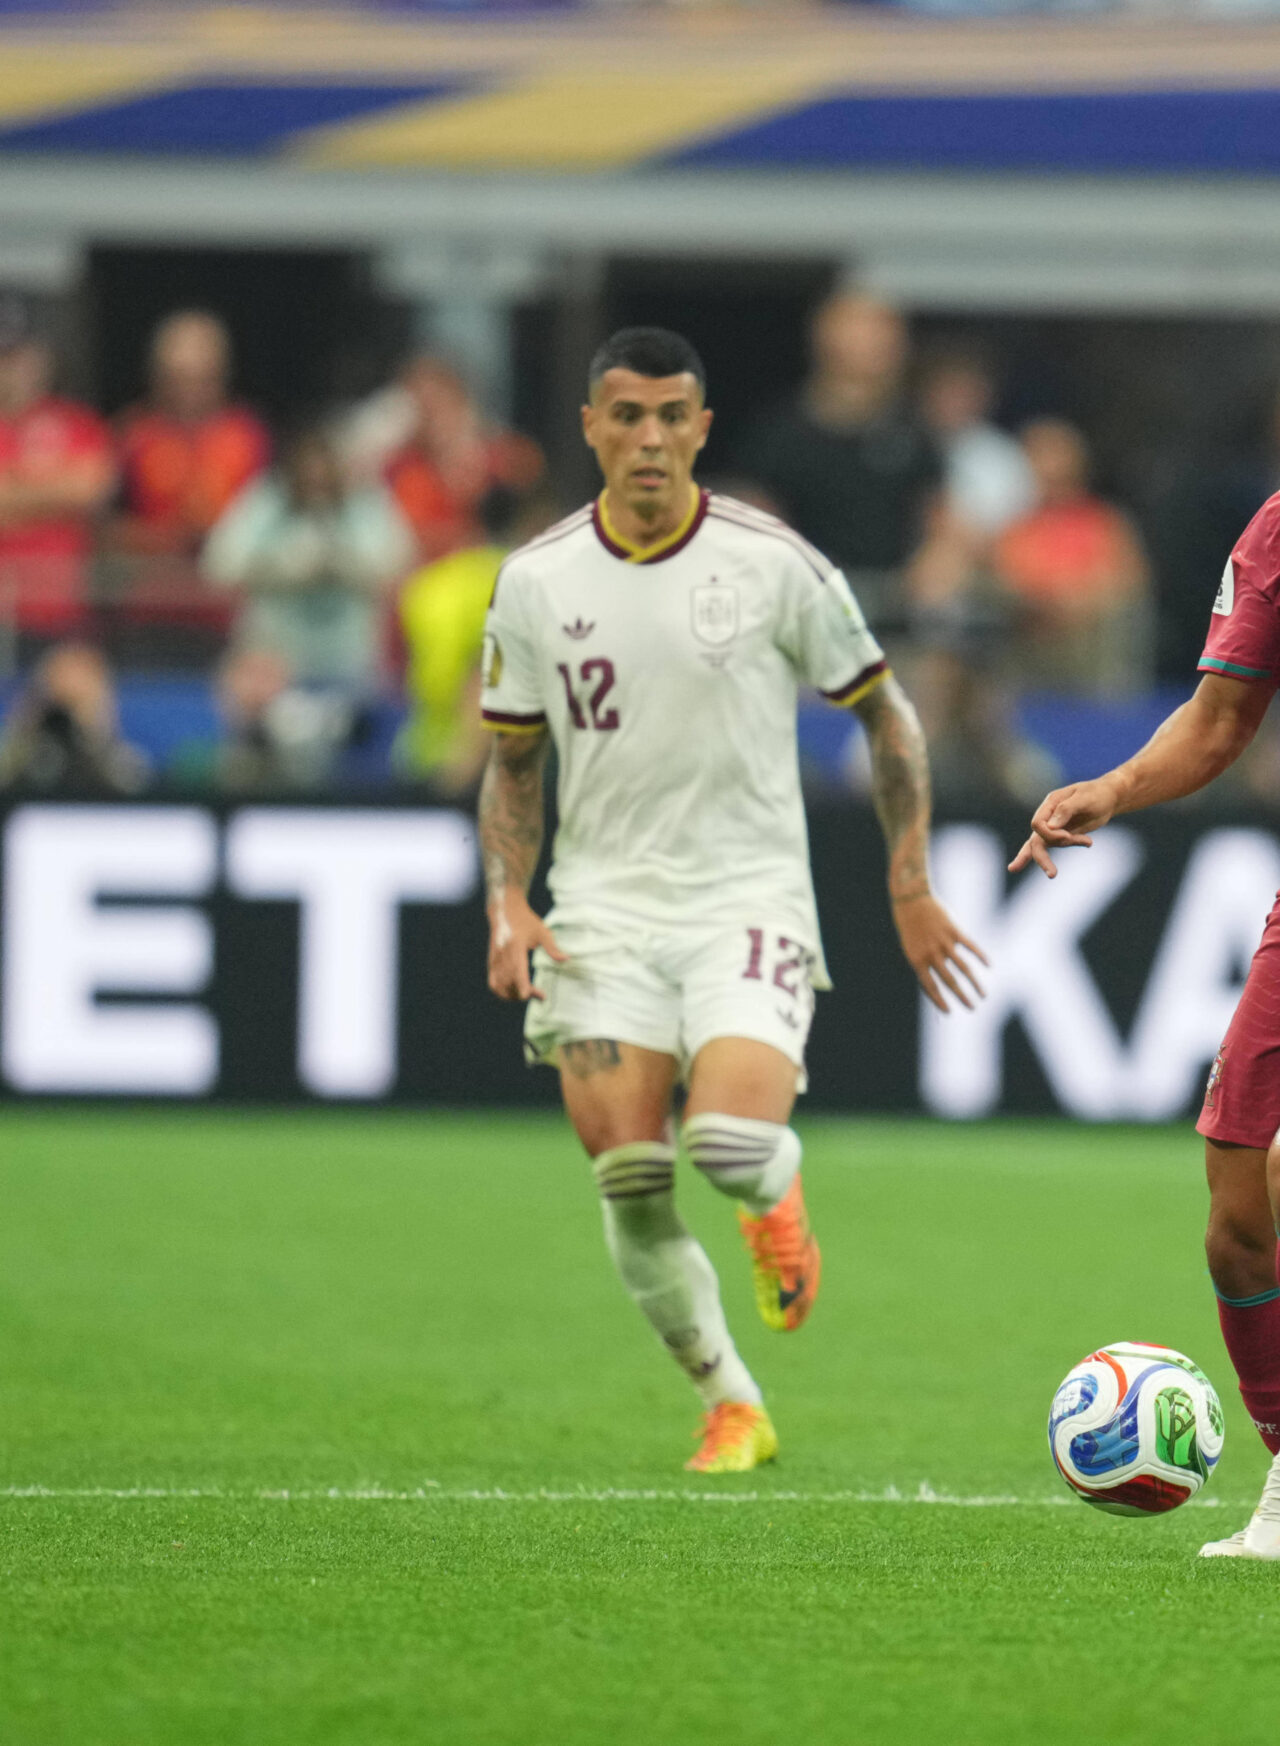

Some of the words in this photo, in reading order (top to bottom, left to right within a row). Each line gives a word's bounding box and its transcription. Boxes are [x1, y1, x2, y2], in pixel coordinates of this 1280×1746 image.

[556, 657, 620, 731] 12
[5, 806, 481, 1098] ET
[742, 927, 805, 999] 12
